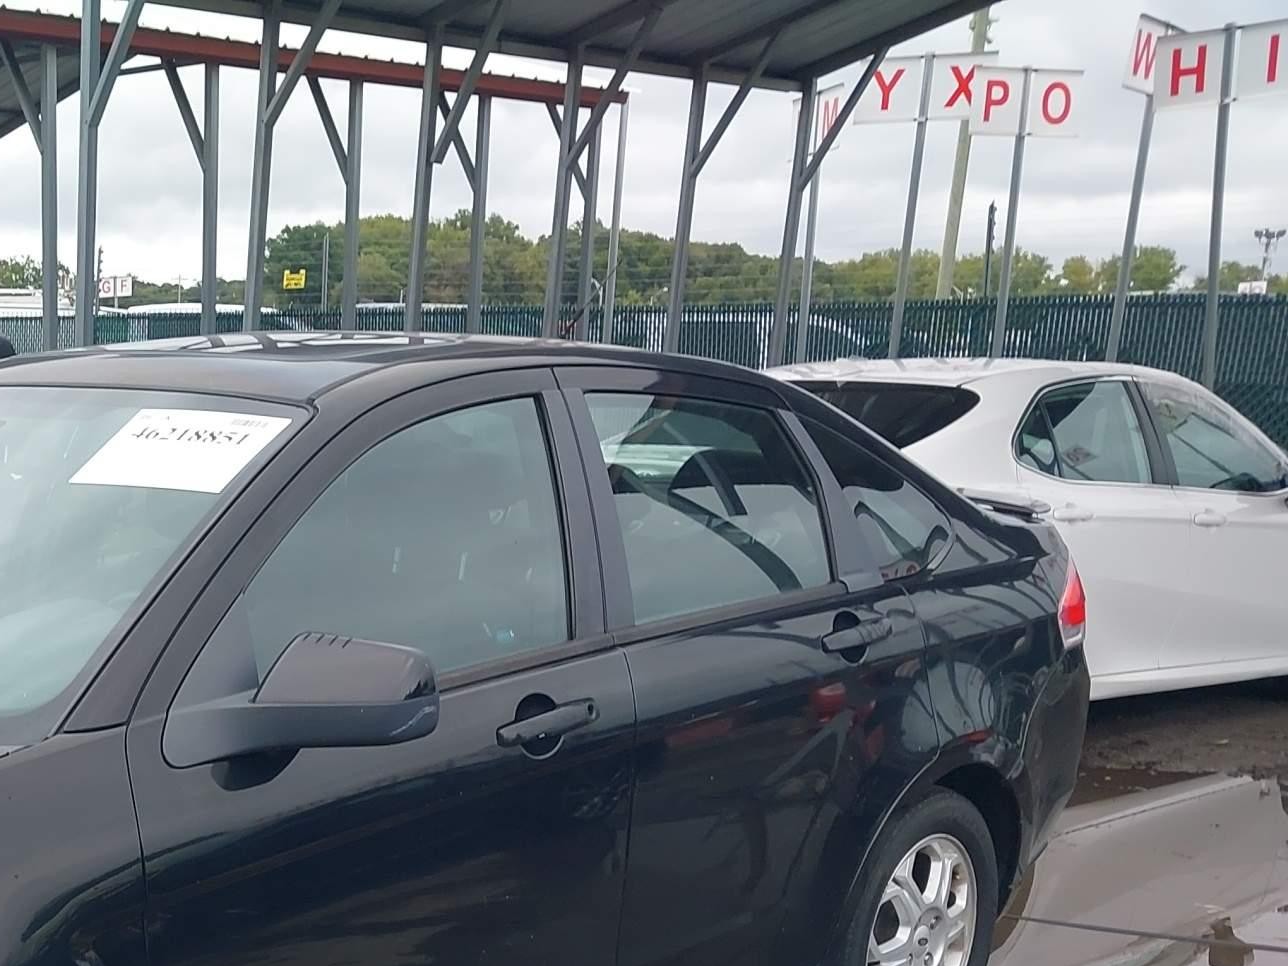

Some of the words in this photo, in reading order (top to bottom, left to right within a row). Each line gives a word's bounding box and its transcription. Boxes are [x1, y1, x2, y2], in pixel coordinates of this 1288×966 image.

[1132, 27, 1158, 81] W
[1169, 43, 1208, 98] H
[872, 67, 907, 112] Y
[132, 426, 251, 446] 46218851
